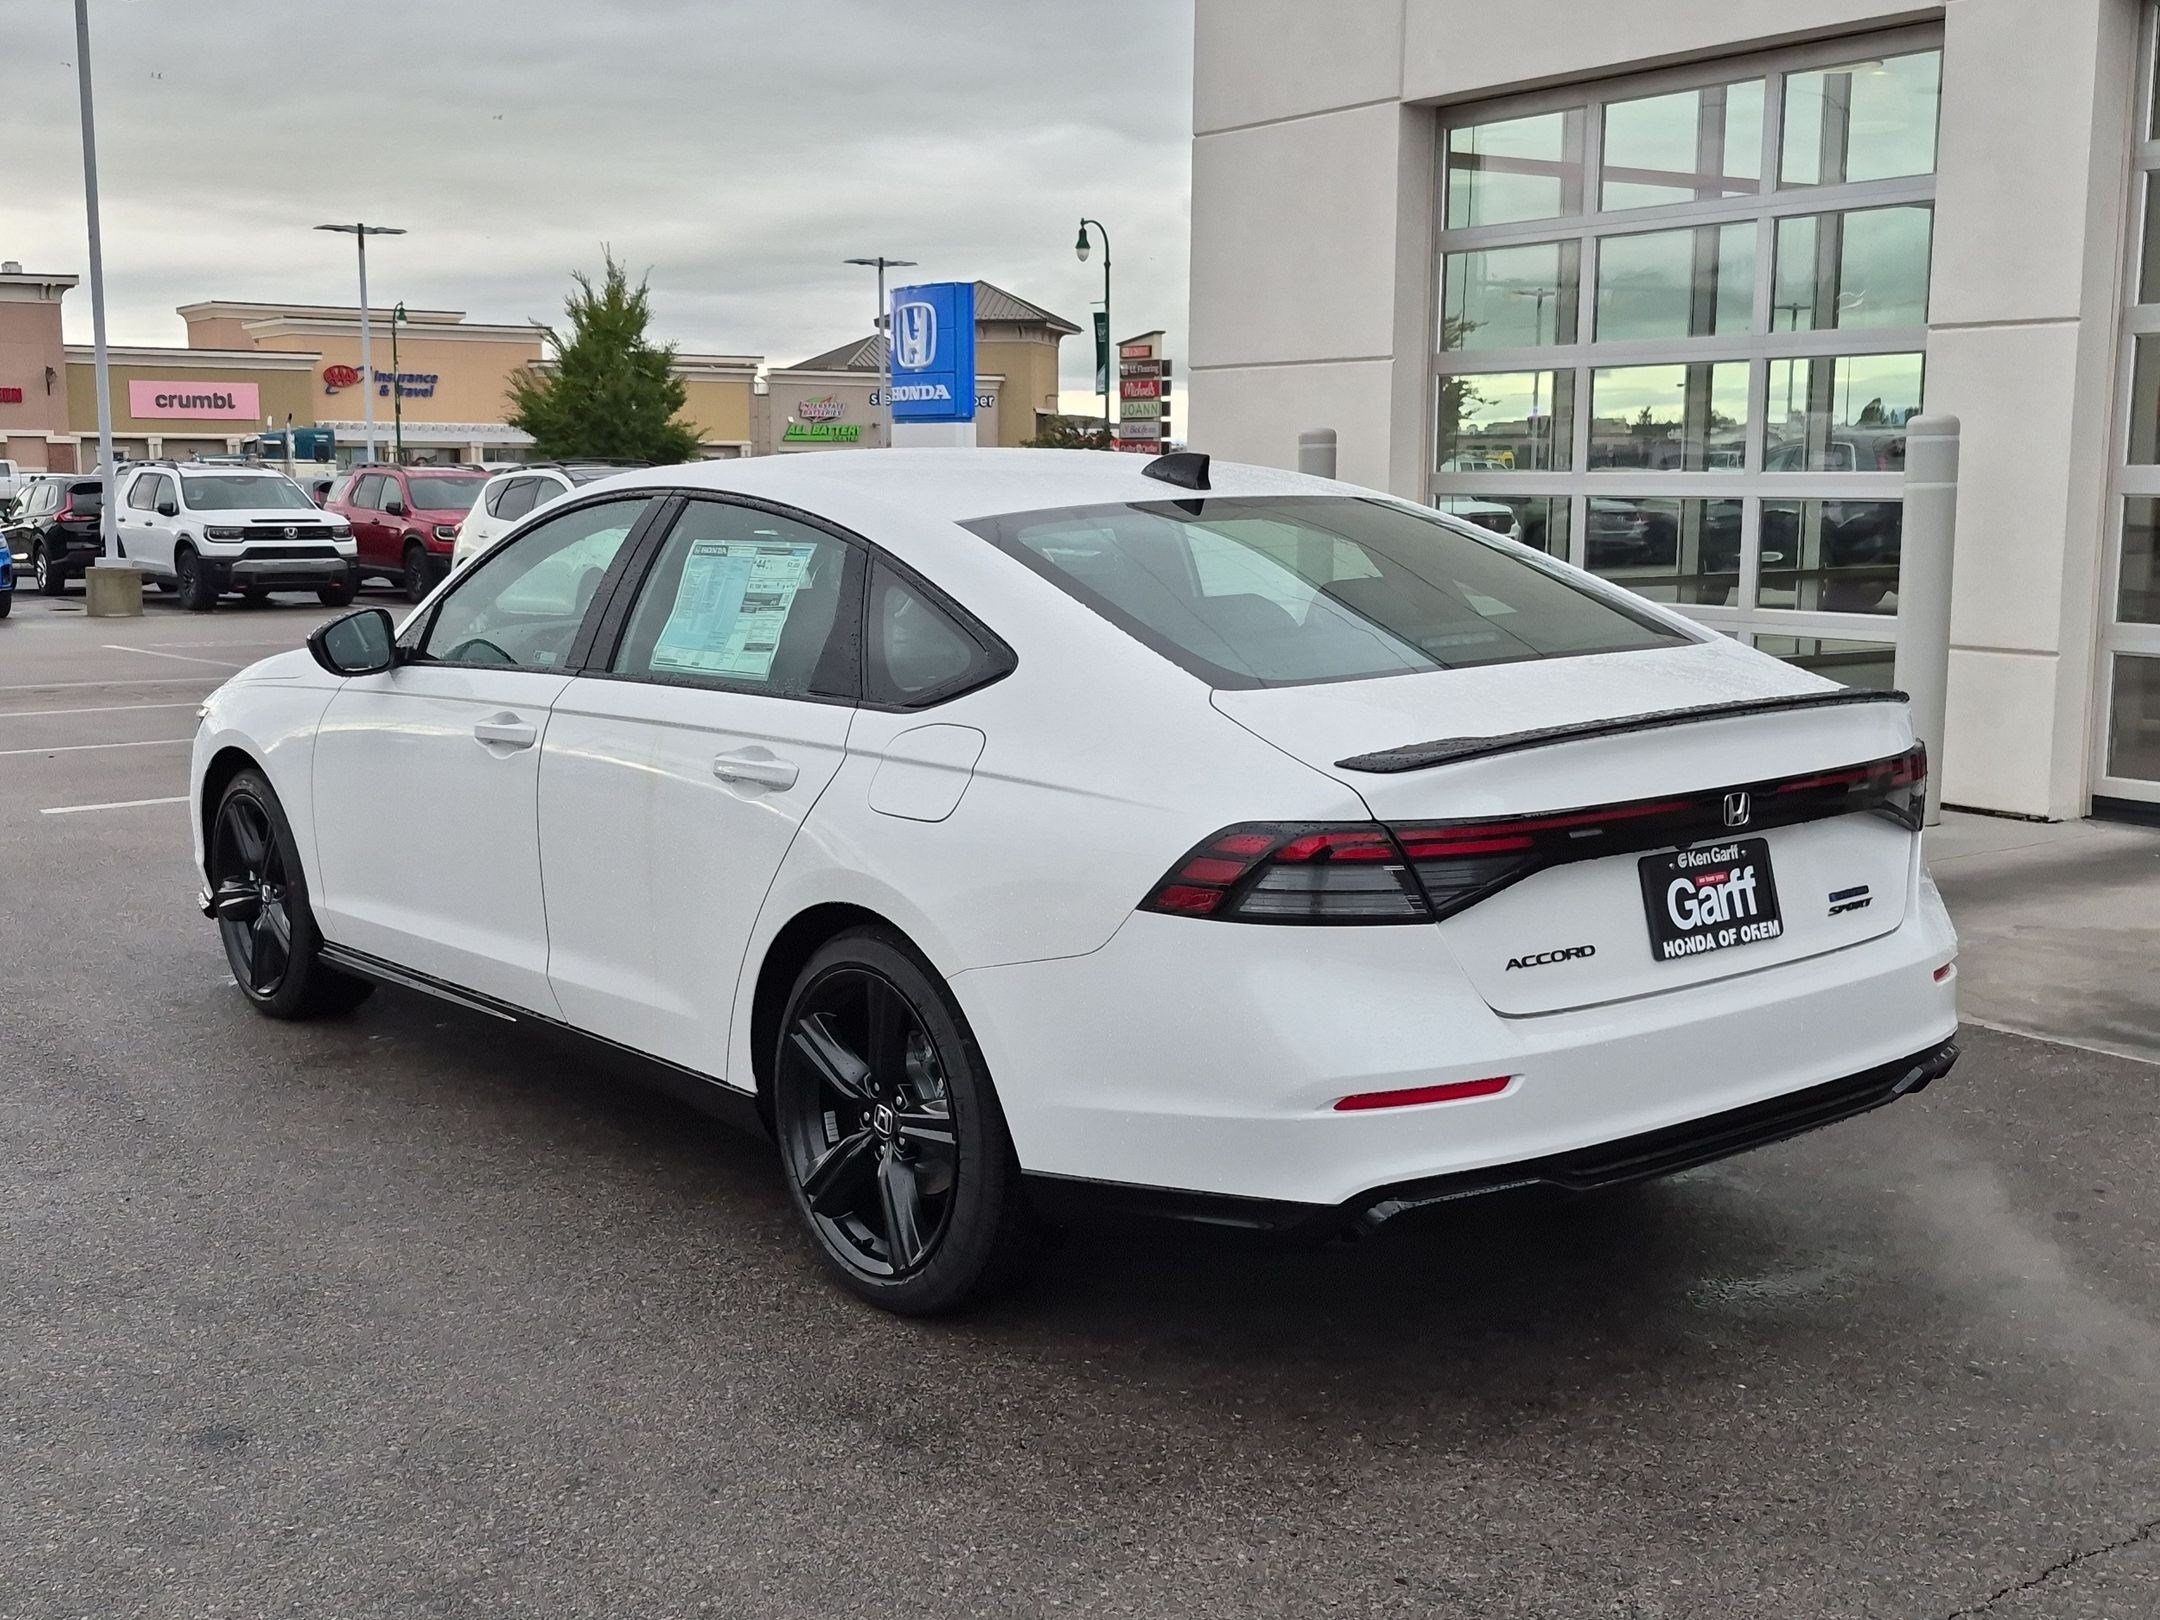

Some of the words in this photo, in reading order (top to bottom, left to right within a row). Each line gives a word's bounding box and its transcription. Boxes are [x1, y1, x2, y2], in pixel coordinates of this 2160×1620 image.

[374, 370, 438, 384] Insrance
[155, 392, 236, 409] crumbl
[891, 384, 951, 401] HONDA
[1121, 403, 1158, 416] JOANN
[787, 424, 809, 435] ALL
[811, 424, 862, 436] BATTERY
[701, 546, 727, 554] HONDA
[1667, 865, 1758, 930] Garff
[1662, 933, 1716, 958] HONDA
[1718, 928, 1738, 947] OF
[1505, 944, 1596, 971] ACCORD
